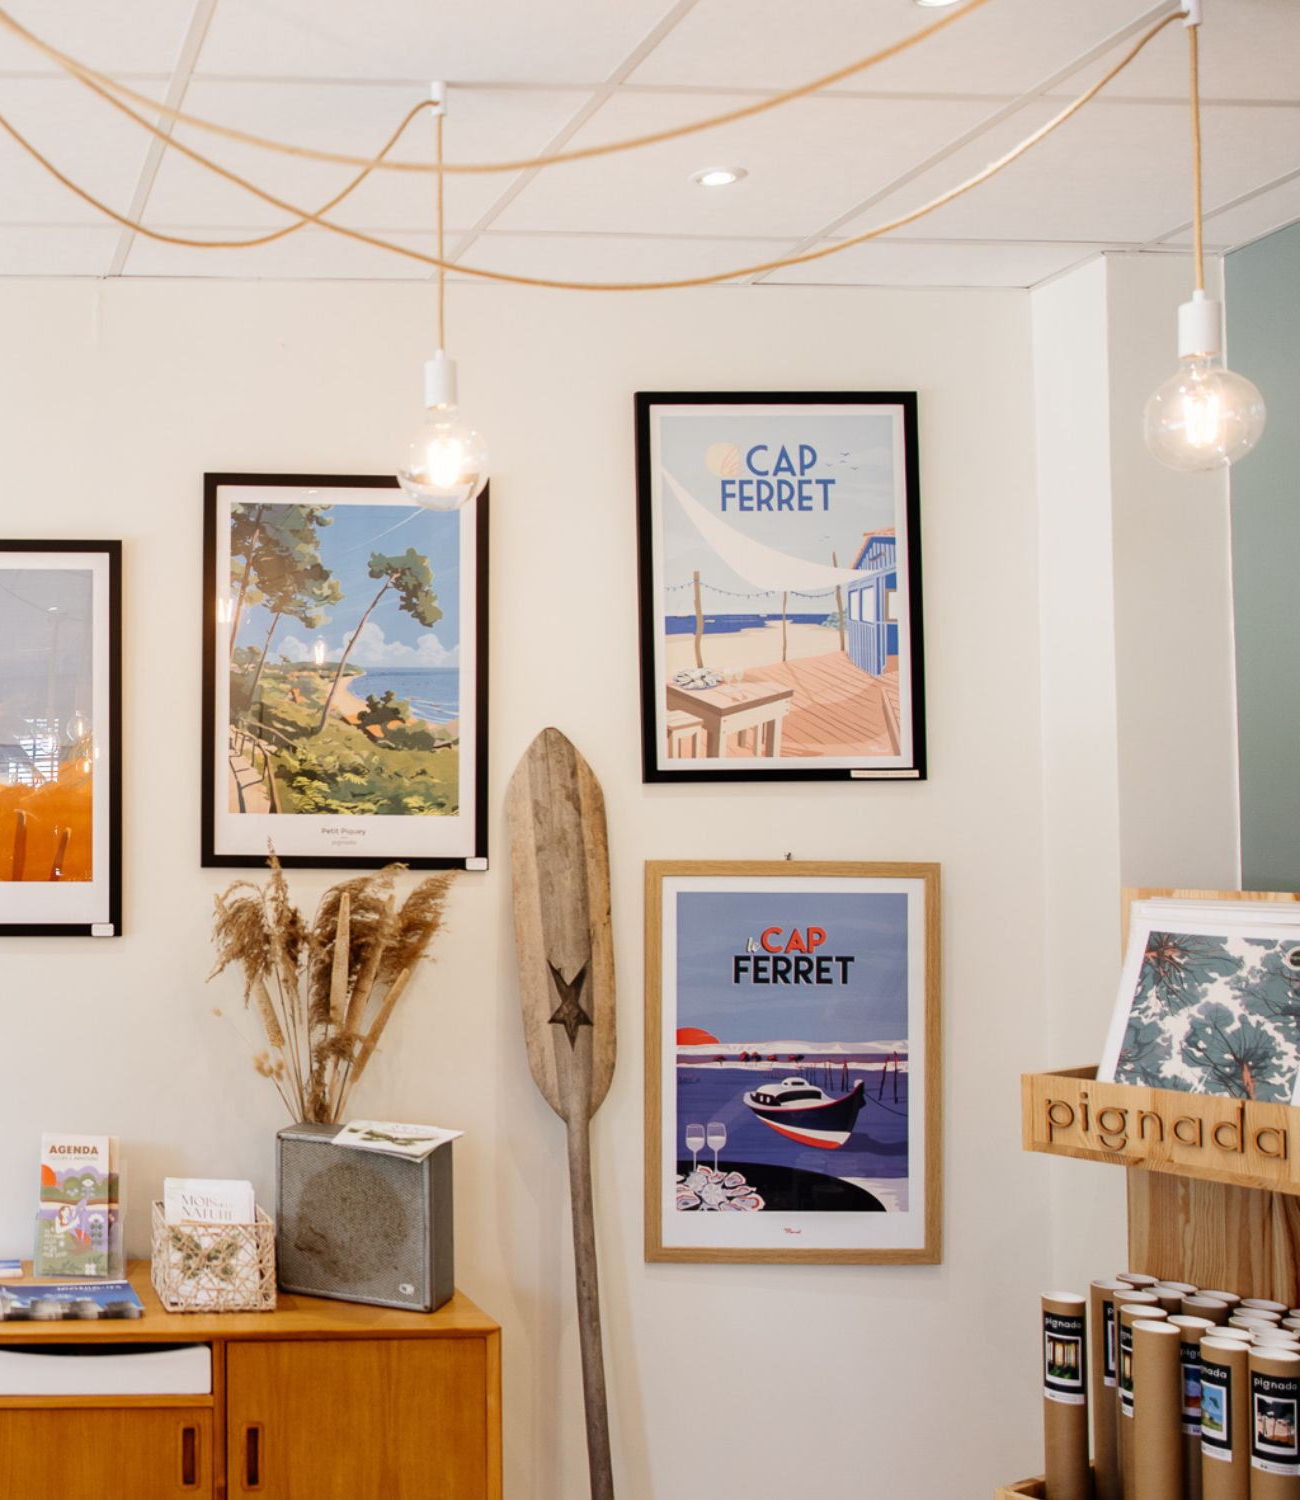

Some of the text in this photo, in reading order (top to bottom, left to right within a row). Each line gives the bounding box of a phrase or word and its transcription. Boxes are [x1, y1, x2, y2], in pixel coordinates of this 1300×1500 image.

[746, 444, 817, 476] CAP
[721, 478, 836, 511] FERRET
[760, 926, 828, 954] CAP
[732, 955, 855, 985] FERRET
[1044, 1091, 1288, 1162] pignada
[49, 1145, 100, 1155] AGENDA
[1044, 1316, 1083, 1330] pignada
[1253, 1376, 1298, 1391] pignada
